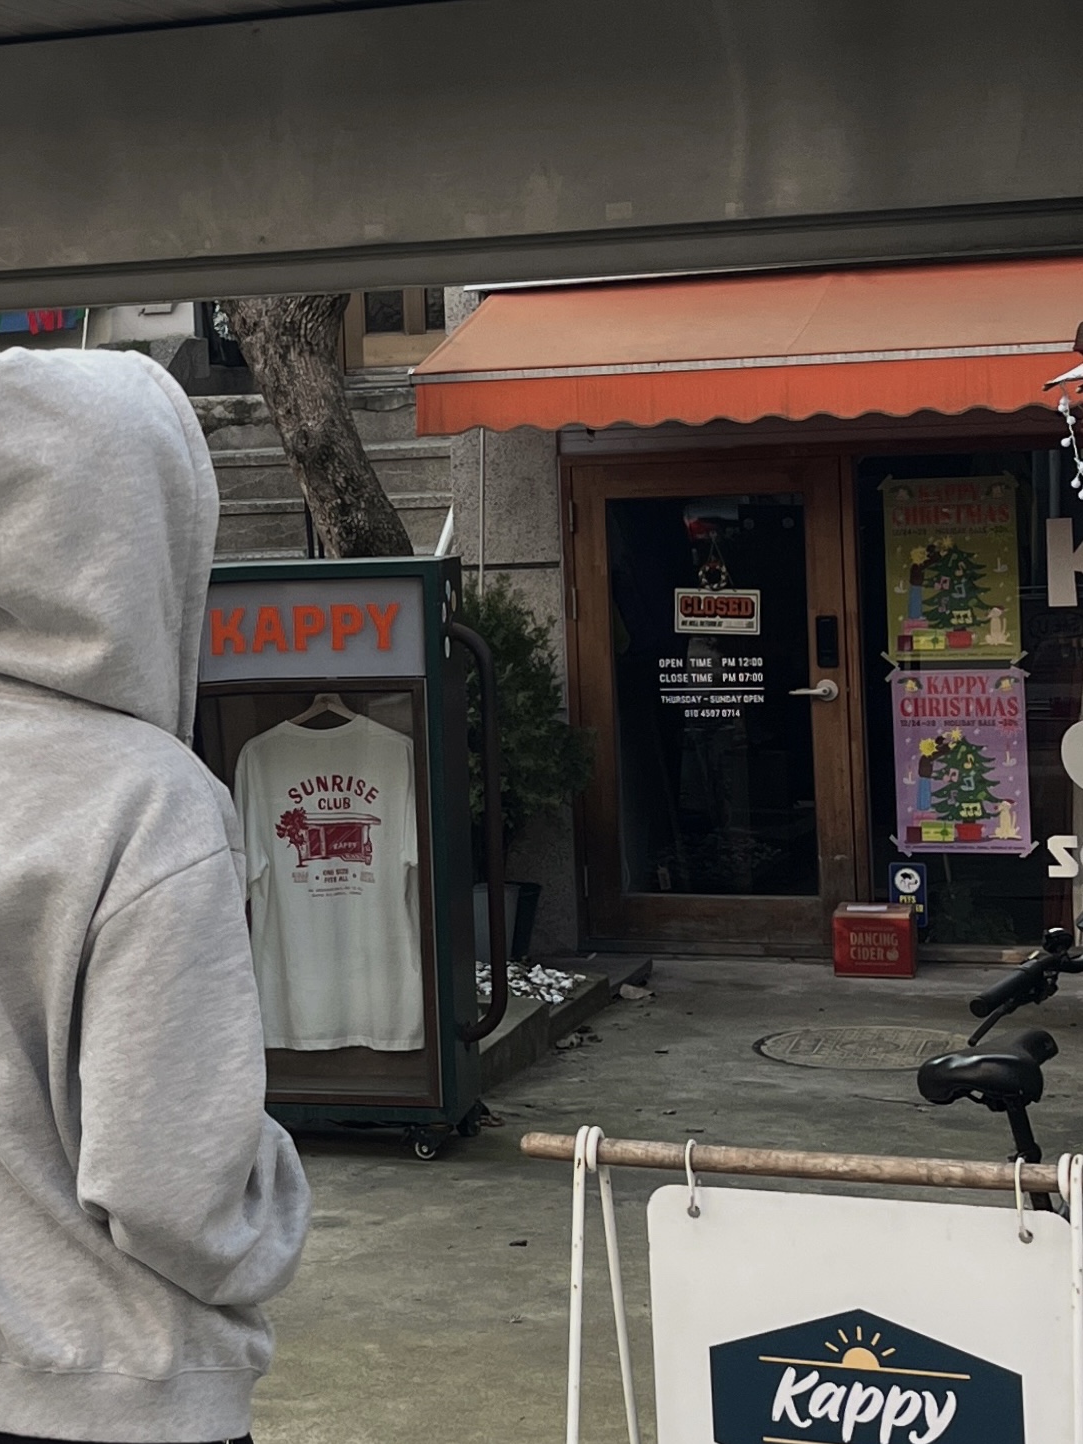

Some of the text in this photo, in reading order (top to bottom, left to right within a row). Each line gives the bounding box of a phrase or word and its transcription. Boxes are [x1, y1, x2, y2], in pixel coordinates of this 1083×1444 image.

[892, 503, 1010, 527] CHRISTMAS
[680, 596, 755, 619] CLOSED
[210, 602, 400, 655] KAPPY
[659, 657, 763, 668] OPEN TIME PM 12:00
[659, 672, 763, 683] CLOSE TIME PM 07:00
[926, 675, 991, 694] KAPPY
[661, 695, 702, 704] THURSDAY
[710, 695, 742, 703] SUNDAY
[743, 695, 764, 703] OPEN
[900, 696, 1019, 717] CHRISTMAS
[943, 719, 976, 727] HOLIDAY
[978, 719, 996, 727] SALE
[288, 775, 379, 804] SUNRISE
[318, 797, 351, 810] CLUB
[899, 895, 916, 904] PETS
[850, 931, 899, 946] DANCING
[850, 946, 885, 961] CIDER
